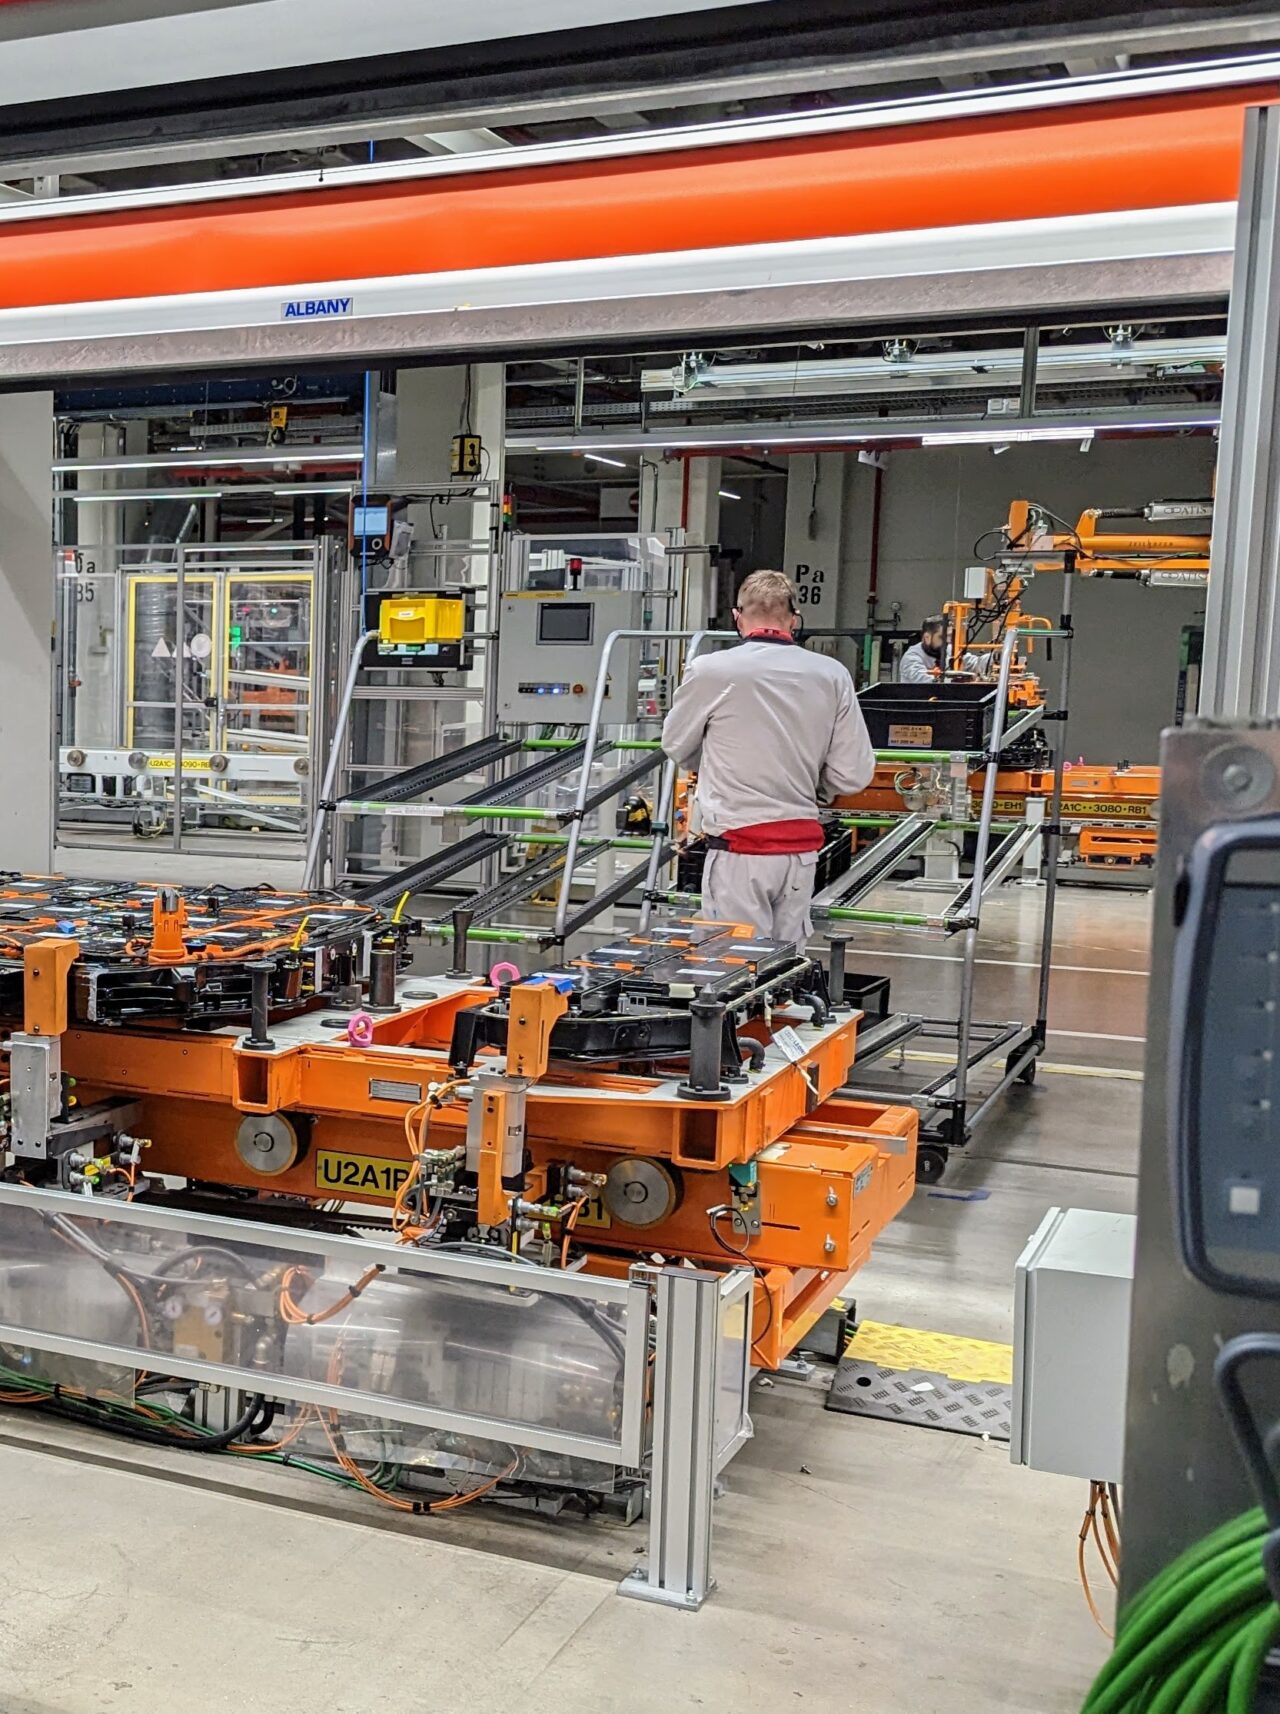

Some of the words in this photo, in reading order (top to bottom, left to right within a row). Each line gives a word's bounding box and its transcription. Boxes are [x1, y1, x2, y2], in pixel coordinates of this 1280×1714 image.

[285, 298, 350, 317] ALBANY
[795, 564, 825, 583] Pa
[798, 585, 822, 605] 36
